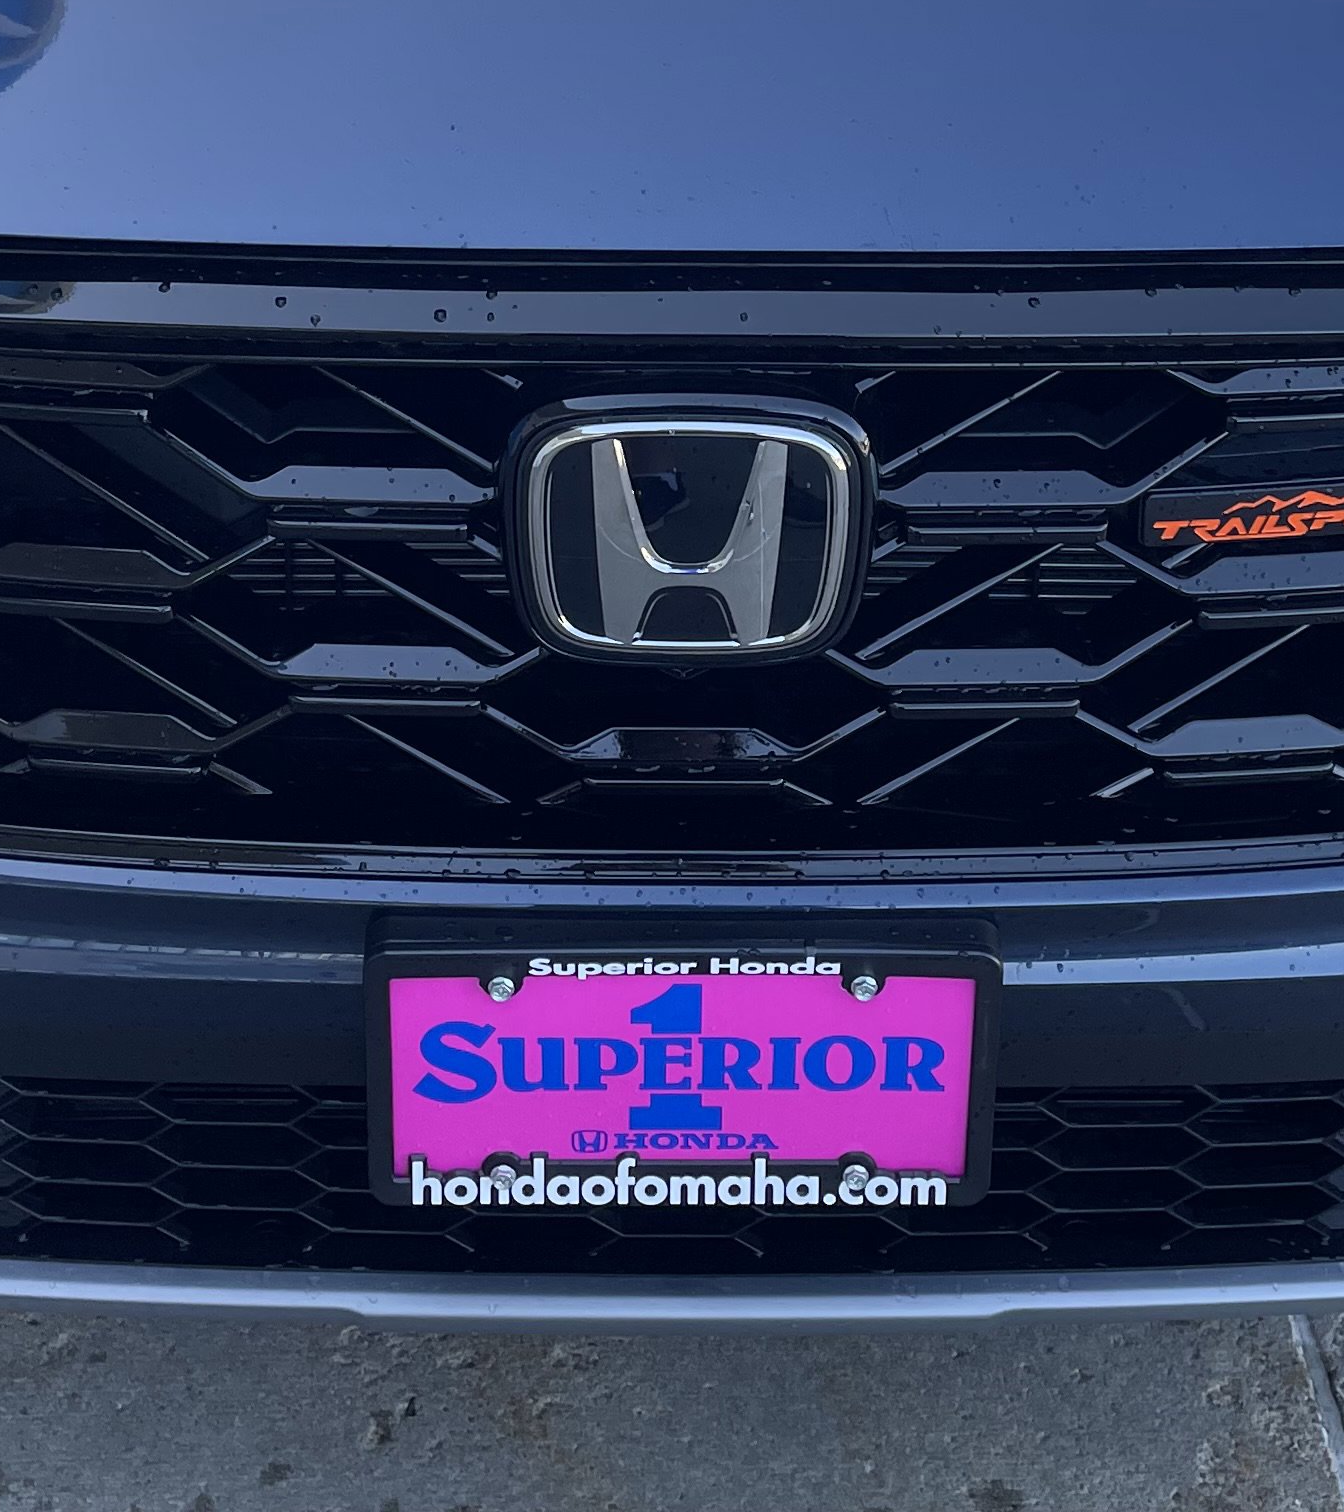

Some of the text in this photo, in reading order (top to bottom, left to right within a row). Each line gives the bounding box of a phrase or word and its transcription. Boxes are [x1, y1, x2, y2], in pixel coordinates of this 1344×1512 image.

[528, 957, 840, 980] Superior Honda
[413, 1021, 945, 1103] SUPERIOR
[614, 1133, 779, 1149] HONDA
[412, 1158, 946, 1206] hondaofomaha.com
